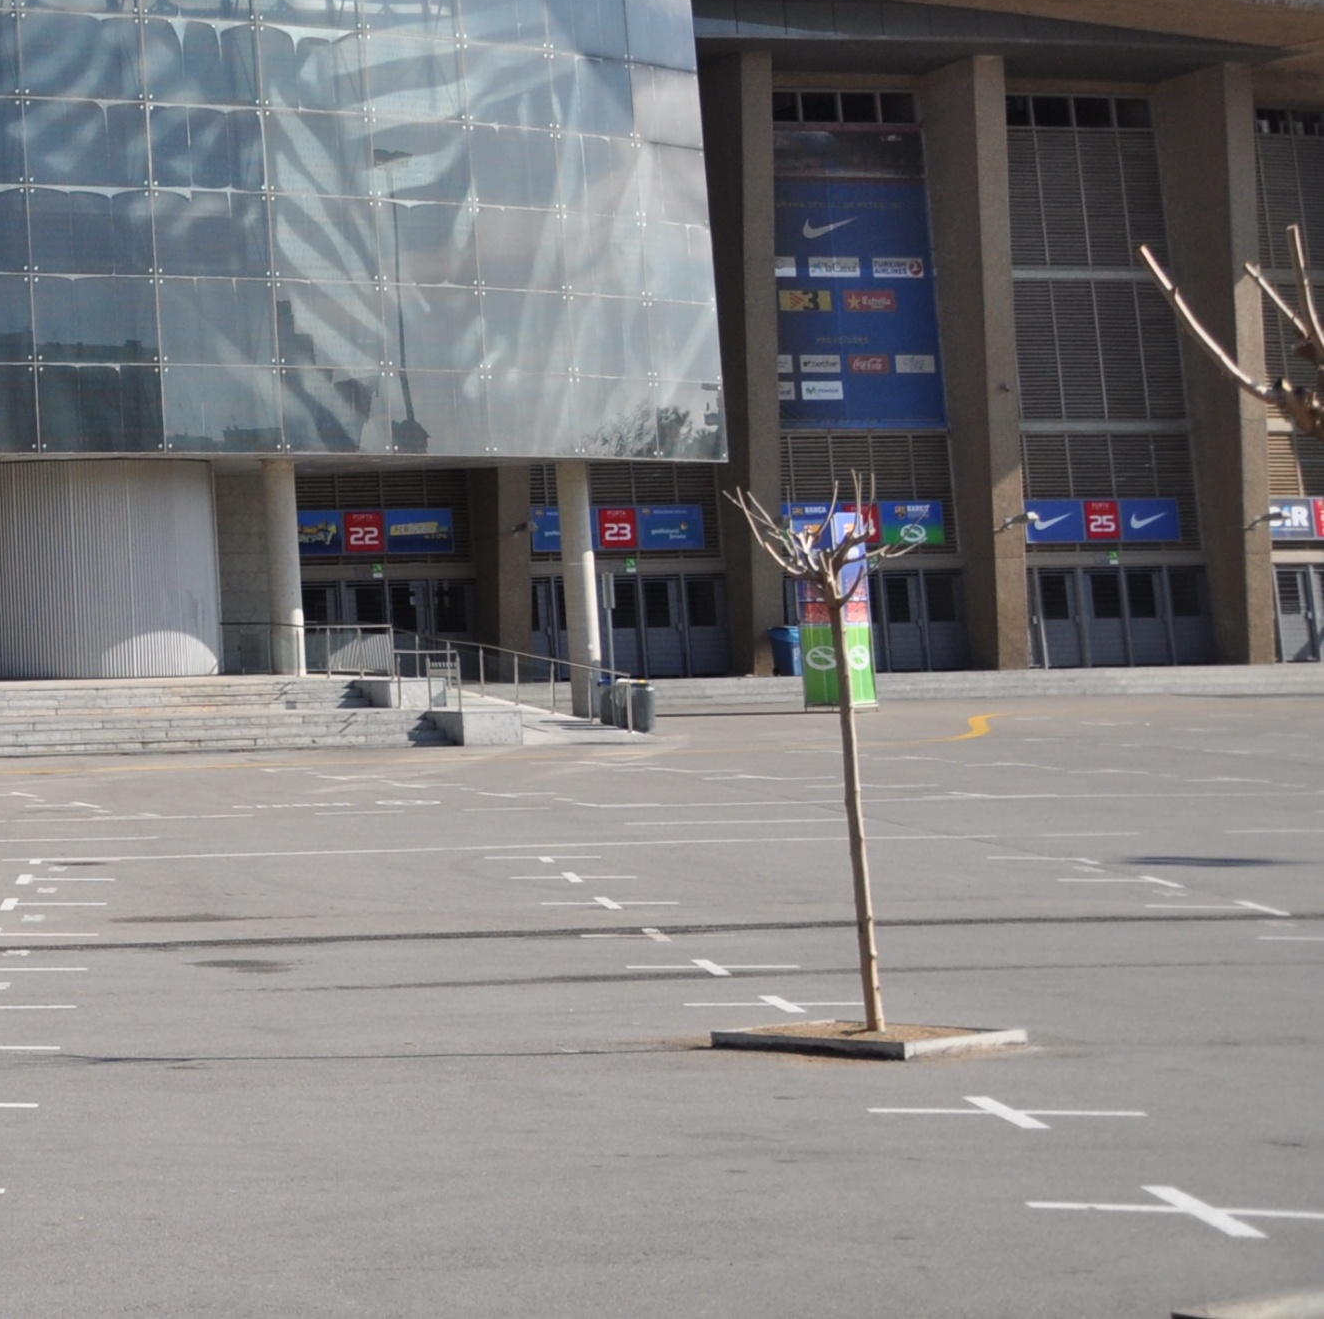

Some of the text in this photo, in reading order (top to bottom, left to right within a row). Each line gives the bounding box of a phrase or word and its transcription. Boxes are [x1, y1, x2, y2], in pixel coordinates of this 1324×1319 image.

[874, 260, 907, 268] TURKISH
[604, 522, 632, 541] 23
[1089, 514, 1117, 532] 25
[349, 526, 380, 545] 22
